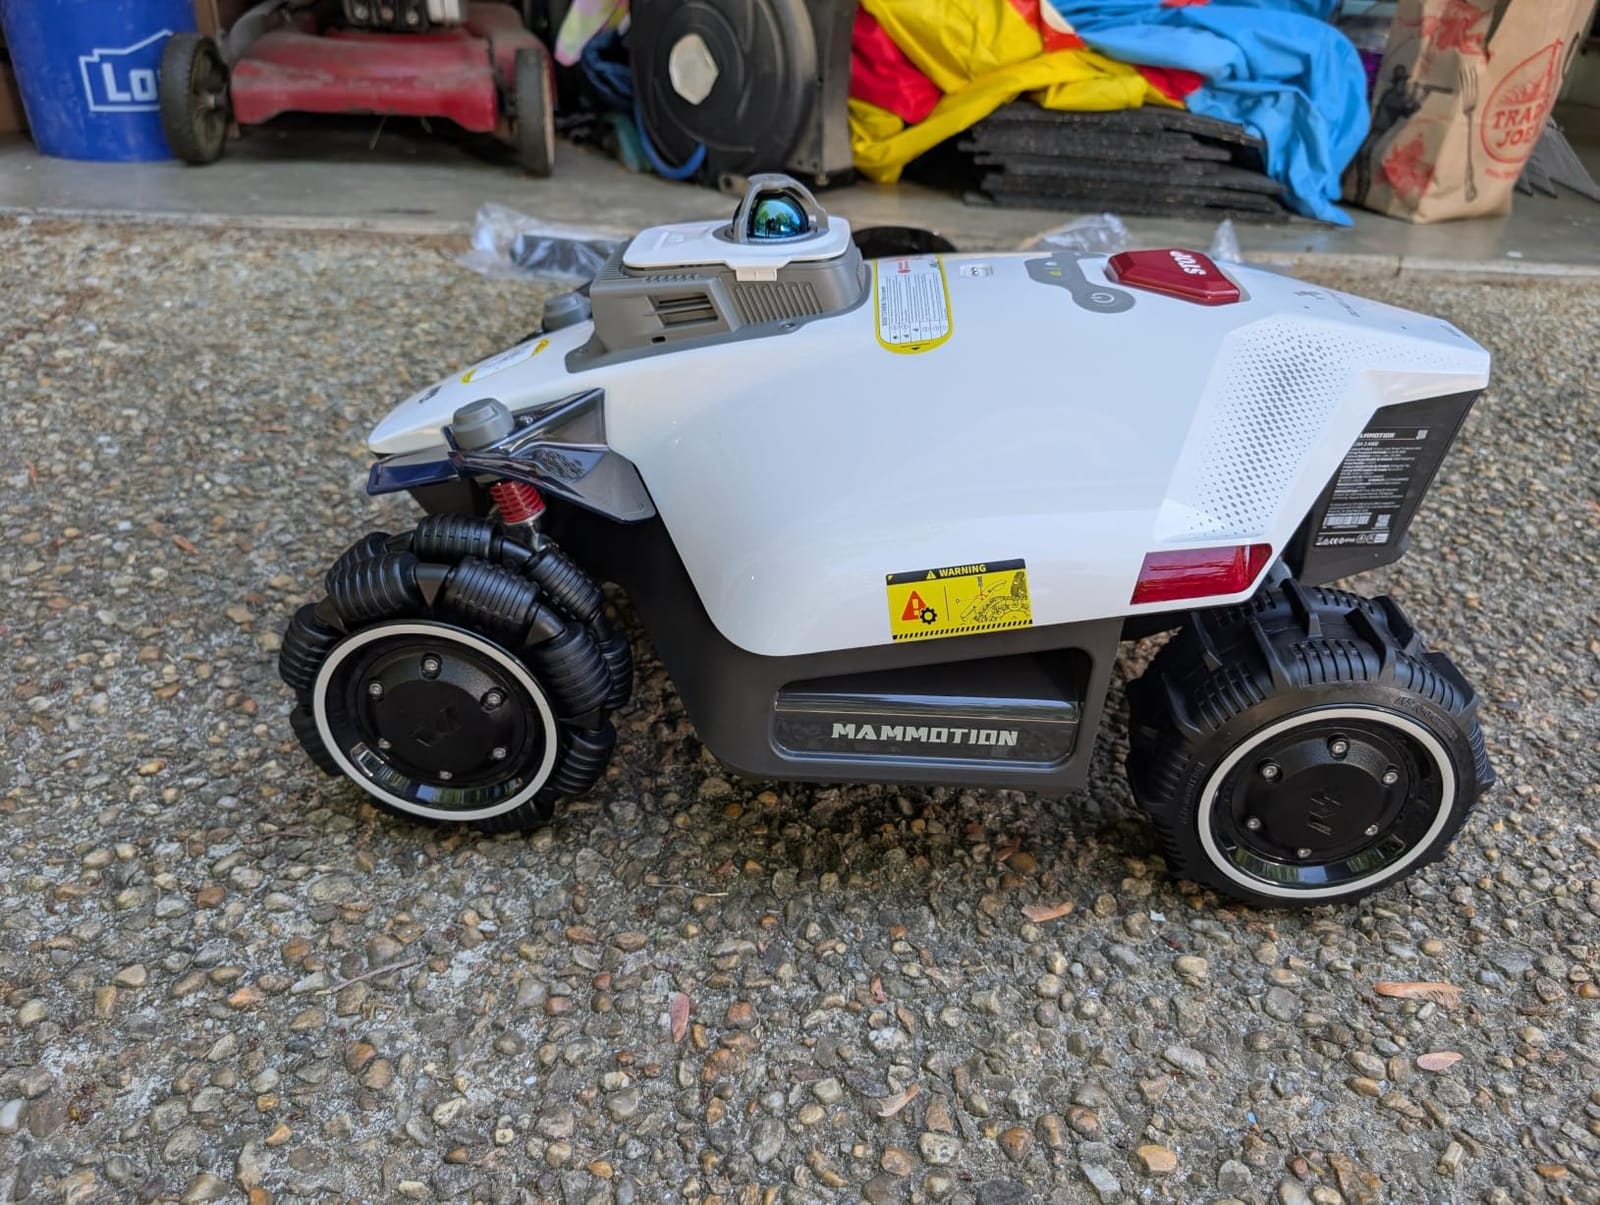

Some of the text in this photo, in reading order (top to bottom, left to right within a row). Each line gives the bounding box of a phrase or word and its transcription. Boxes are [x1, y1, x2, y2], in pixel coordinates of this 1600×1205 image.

[101, 62, 159, 101] Lo
[1169, 251, 1207, 276] STOP
[938, 563, 987, 578] WARNING
[831, 722, 1018, 747] MAMMOTION
